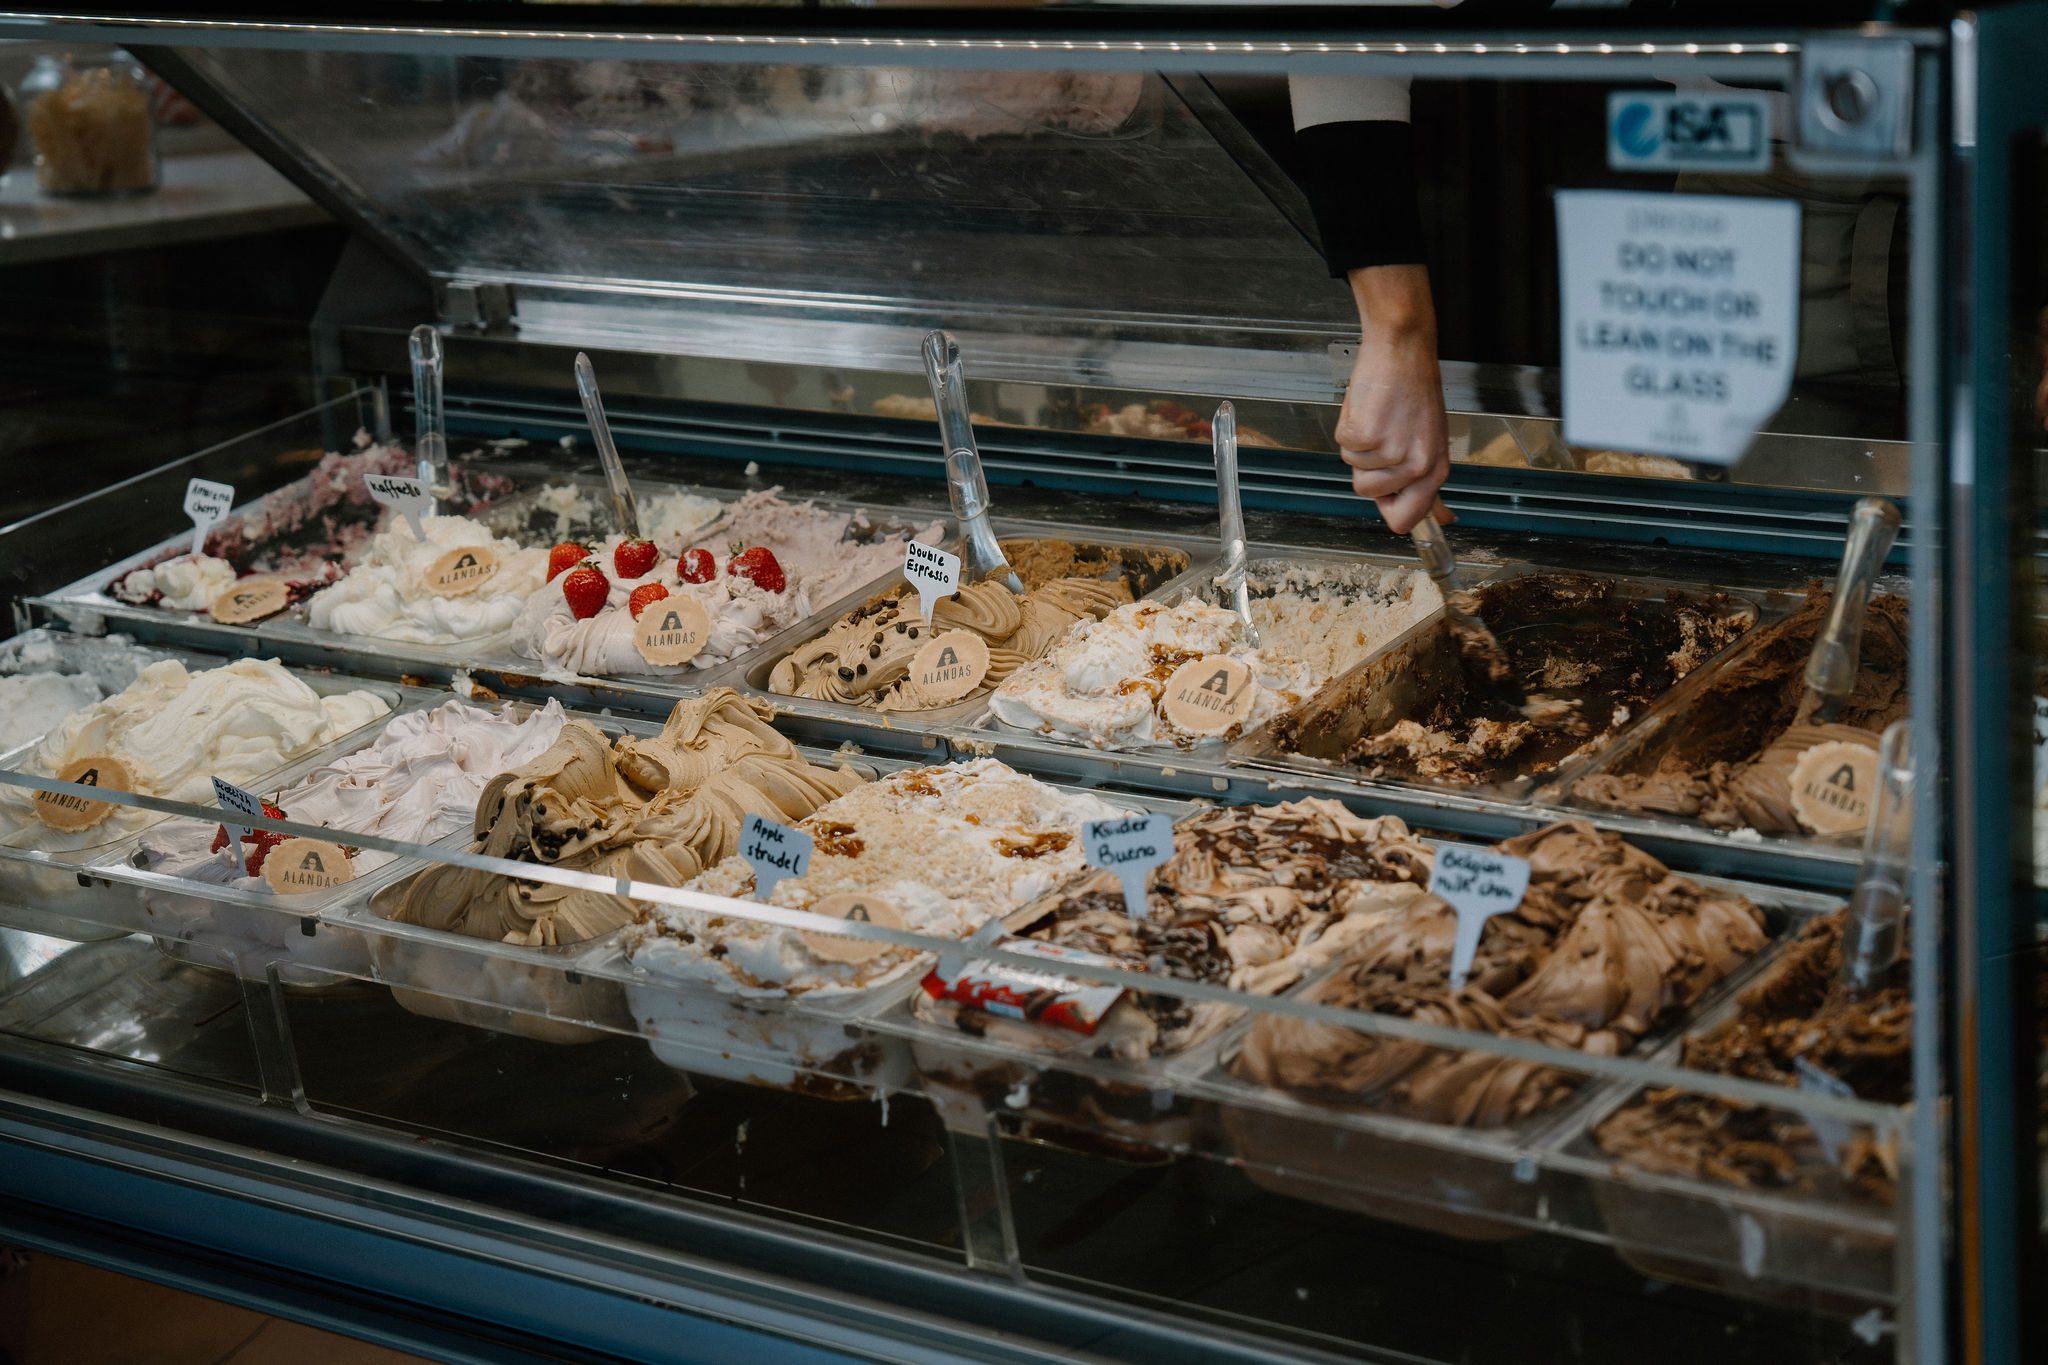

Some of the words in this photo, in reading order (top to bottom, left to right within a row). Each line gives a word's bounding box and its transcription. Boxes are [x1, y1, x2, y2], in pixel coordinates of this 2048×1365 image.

[1617, 242, 1665, 273] DO
[1673, 247, 1735, 276] NOT
[1600, 282, 1706, 317] TOUCH
[1715, 290, 1760, 321] OR
[1577, 320, 1659, 350] LEAN
[1667, 327, 1711, 358] ON
[1721, 331, 1776, 366] THE
[1625, 365, 1729, 402] GLASS
[909, 543, 945, 567] Double
[438, 564, 492, 585] ALANDAS
[906, 558, 949, 584] Espresso
[646, 632, 696, 647] ALANDAS
[923, 664, 972, 686] ALANDAS
[1177, 688, 1239, 716] ALANDAS
[38, 790, 90, 813] ALANDAS
[1804, 782, 1866, 817] ALANDAS
[752, 817, 784, 844] Apple
[747, 841, 800, 876] strudel
[1098, 843, 1156, 866] Bueno
[283, 870, 340, 889] ALANDAS
